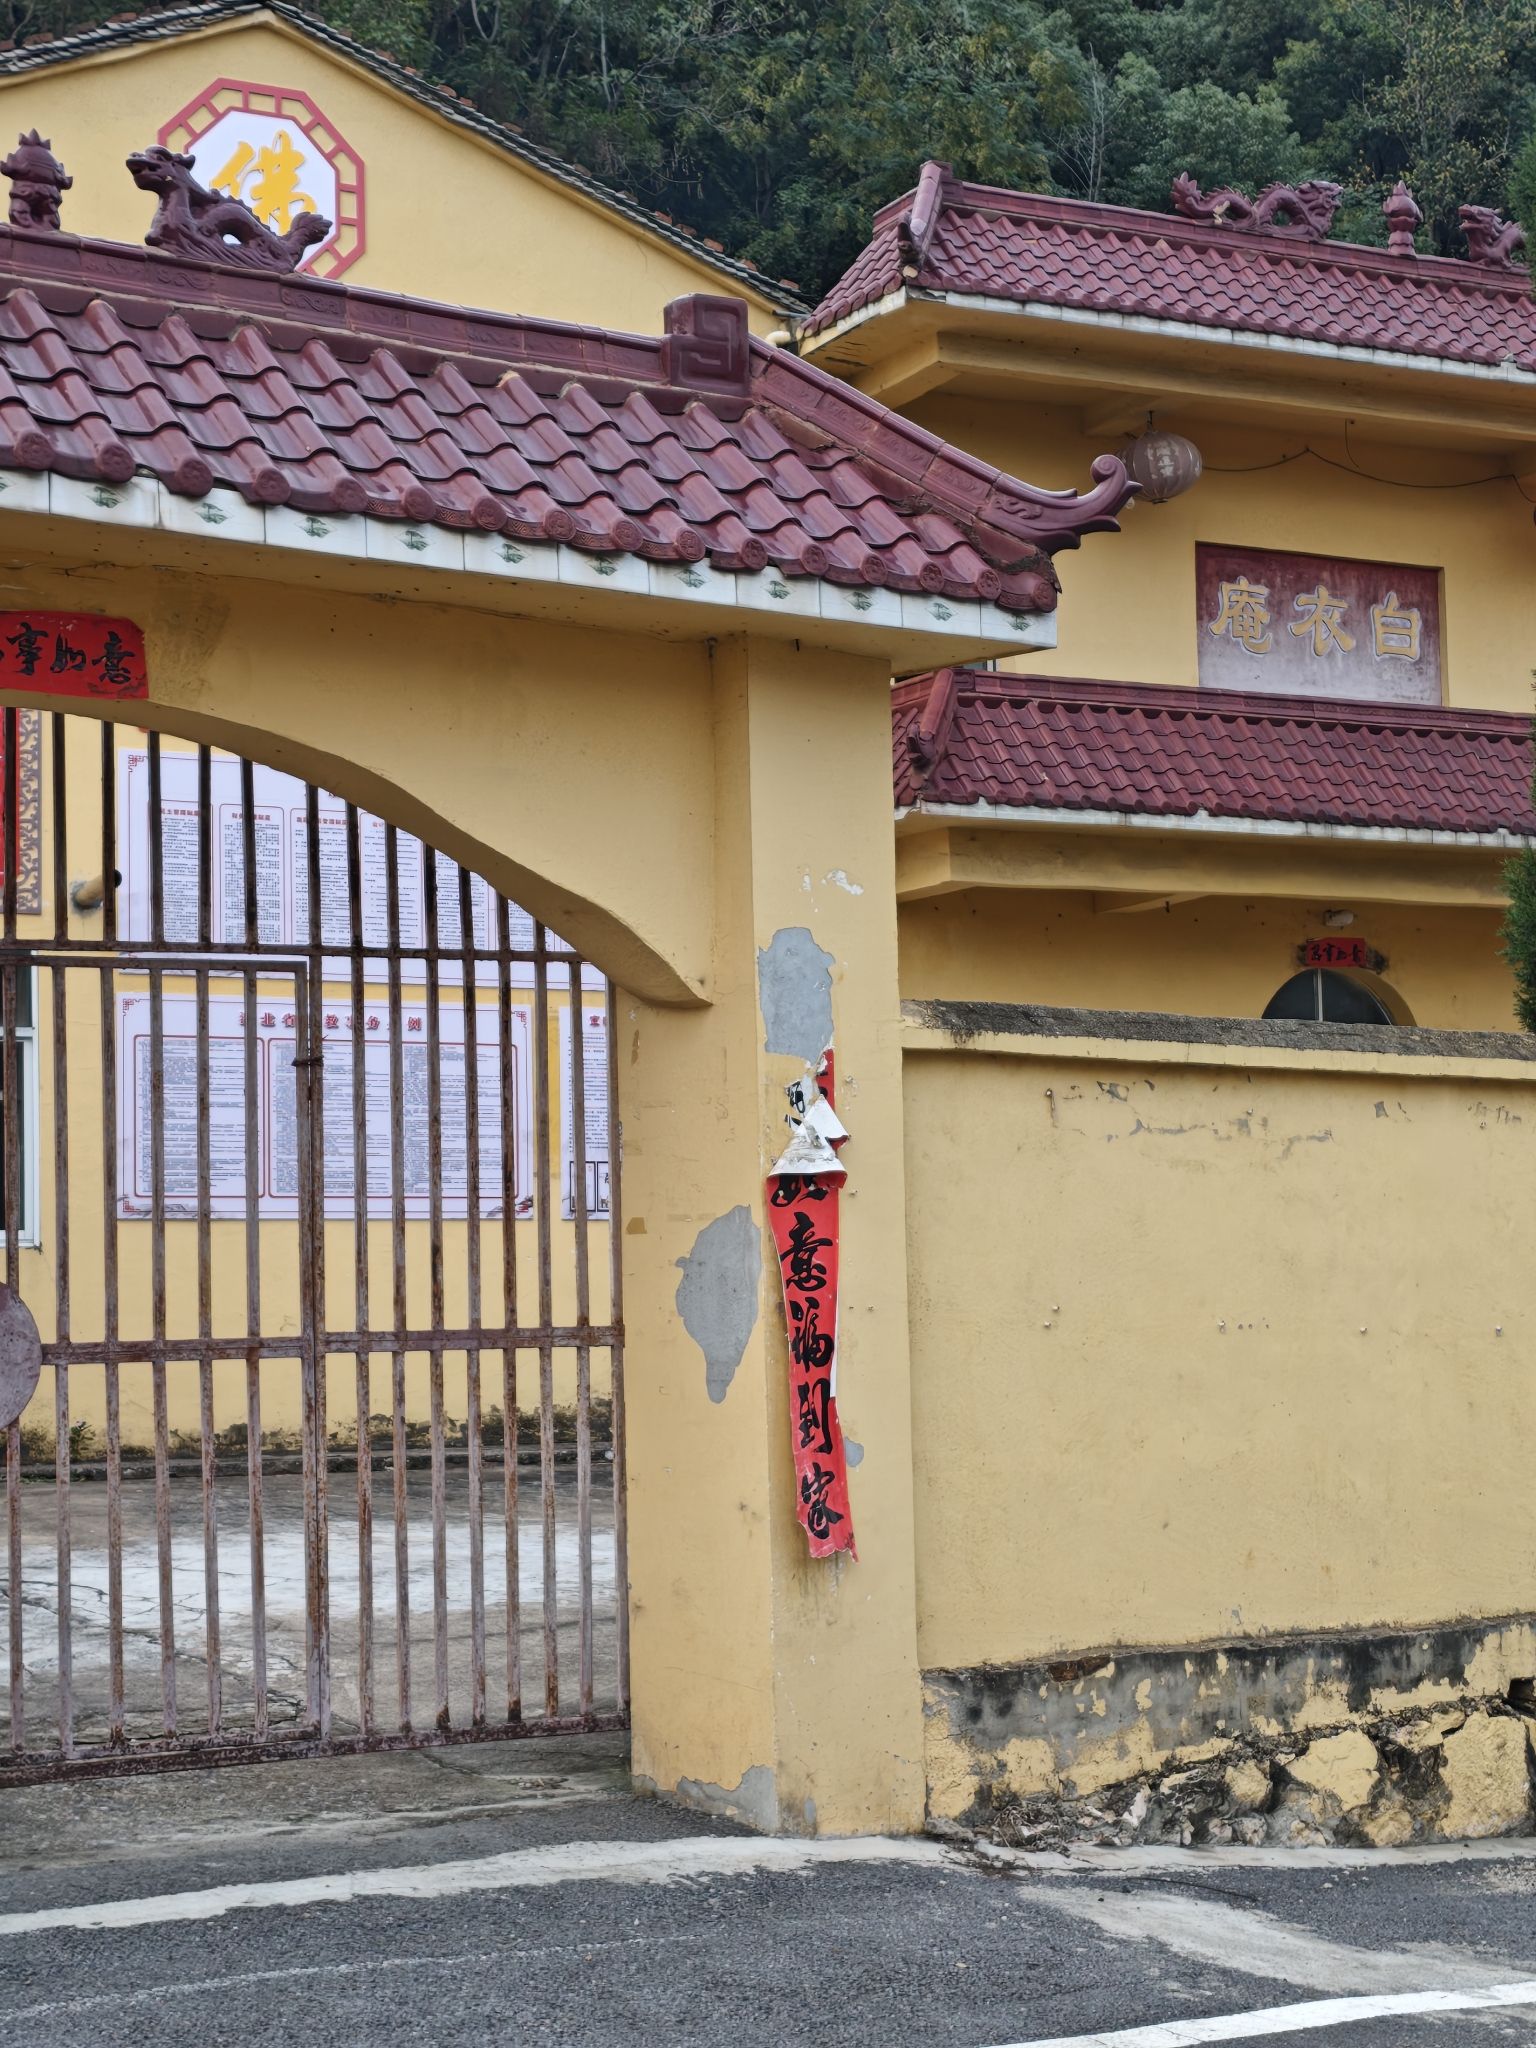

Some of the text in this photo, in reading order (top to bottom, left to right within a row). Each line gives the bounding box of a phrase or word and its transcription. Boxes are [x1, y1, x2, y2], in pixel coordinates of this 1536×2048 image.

[209, 128, 317, 236] 佛
[0, 621, 136, 685] 事如意
